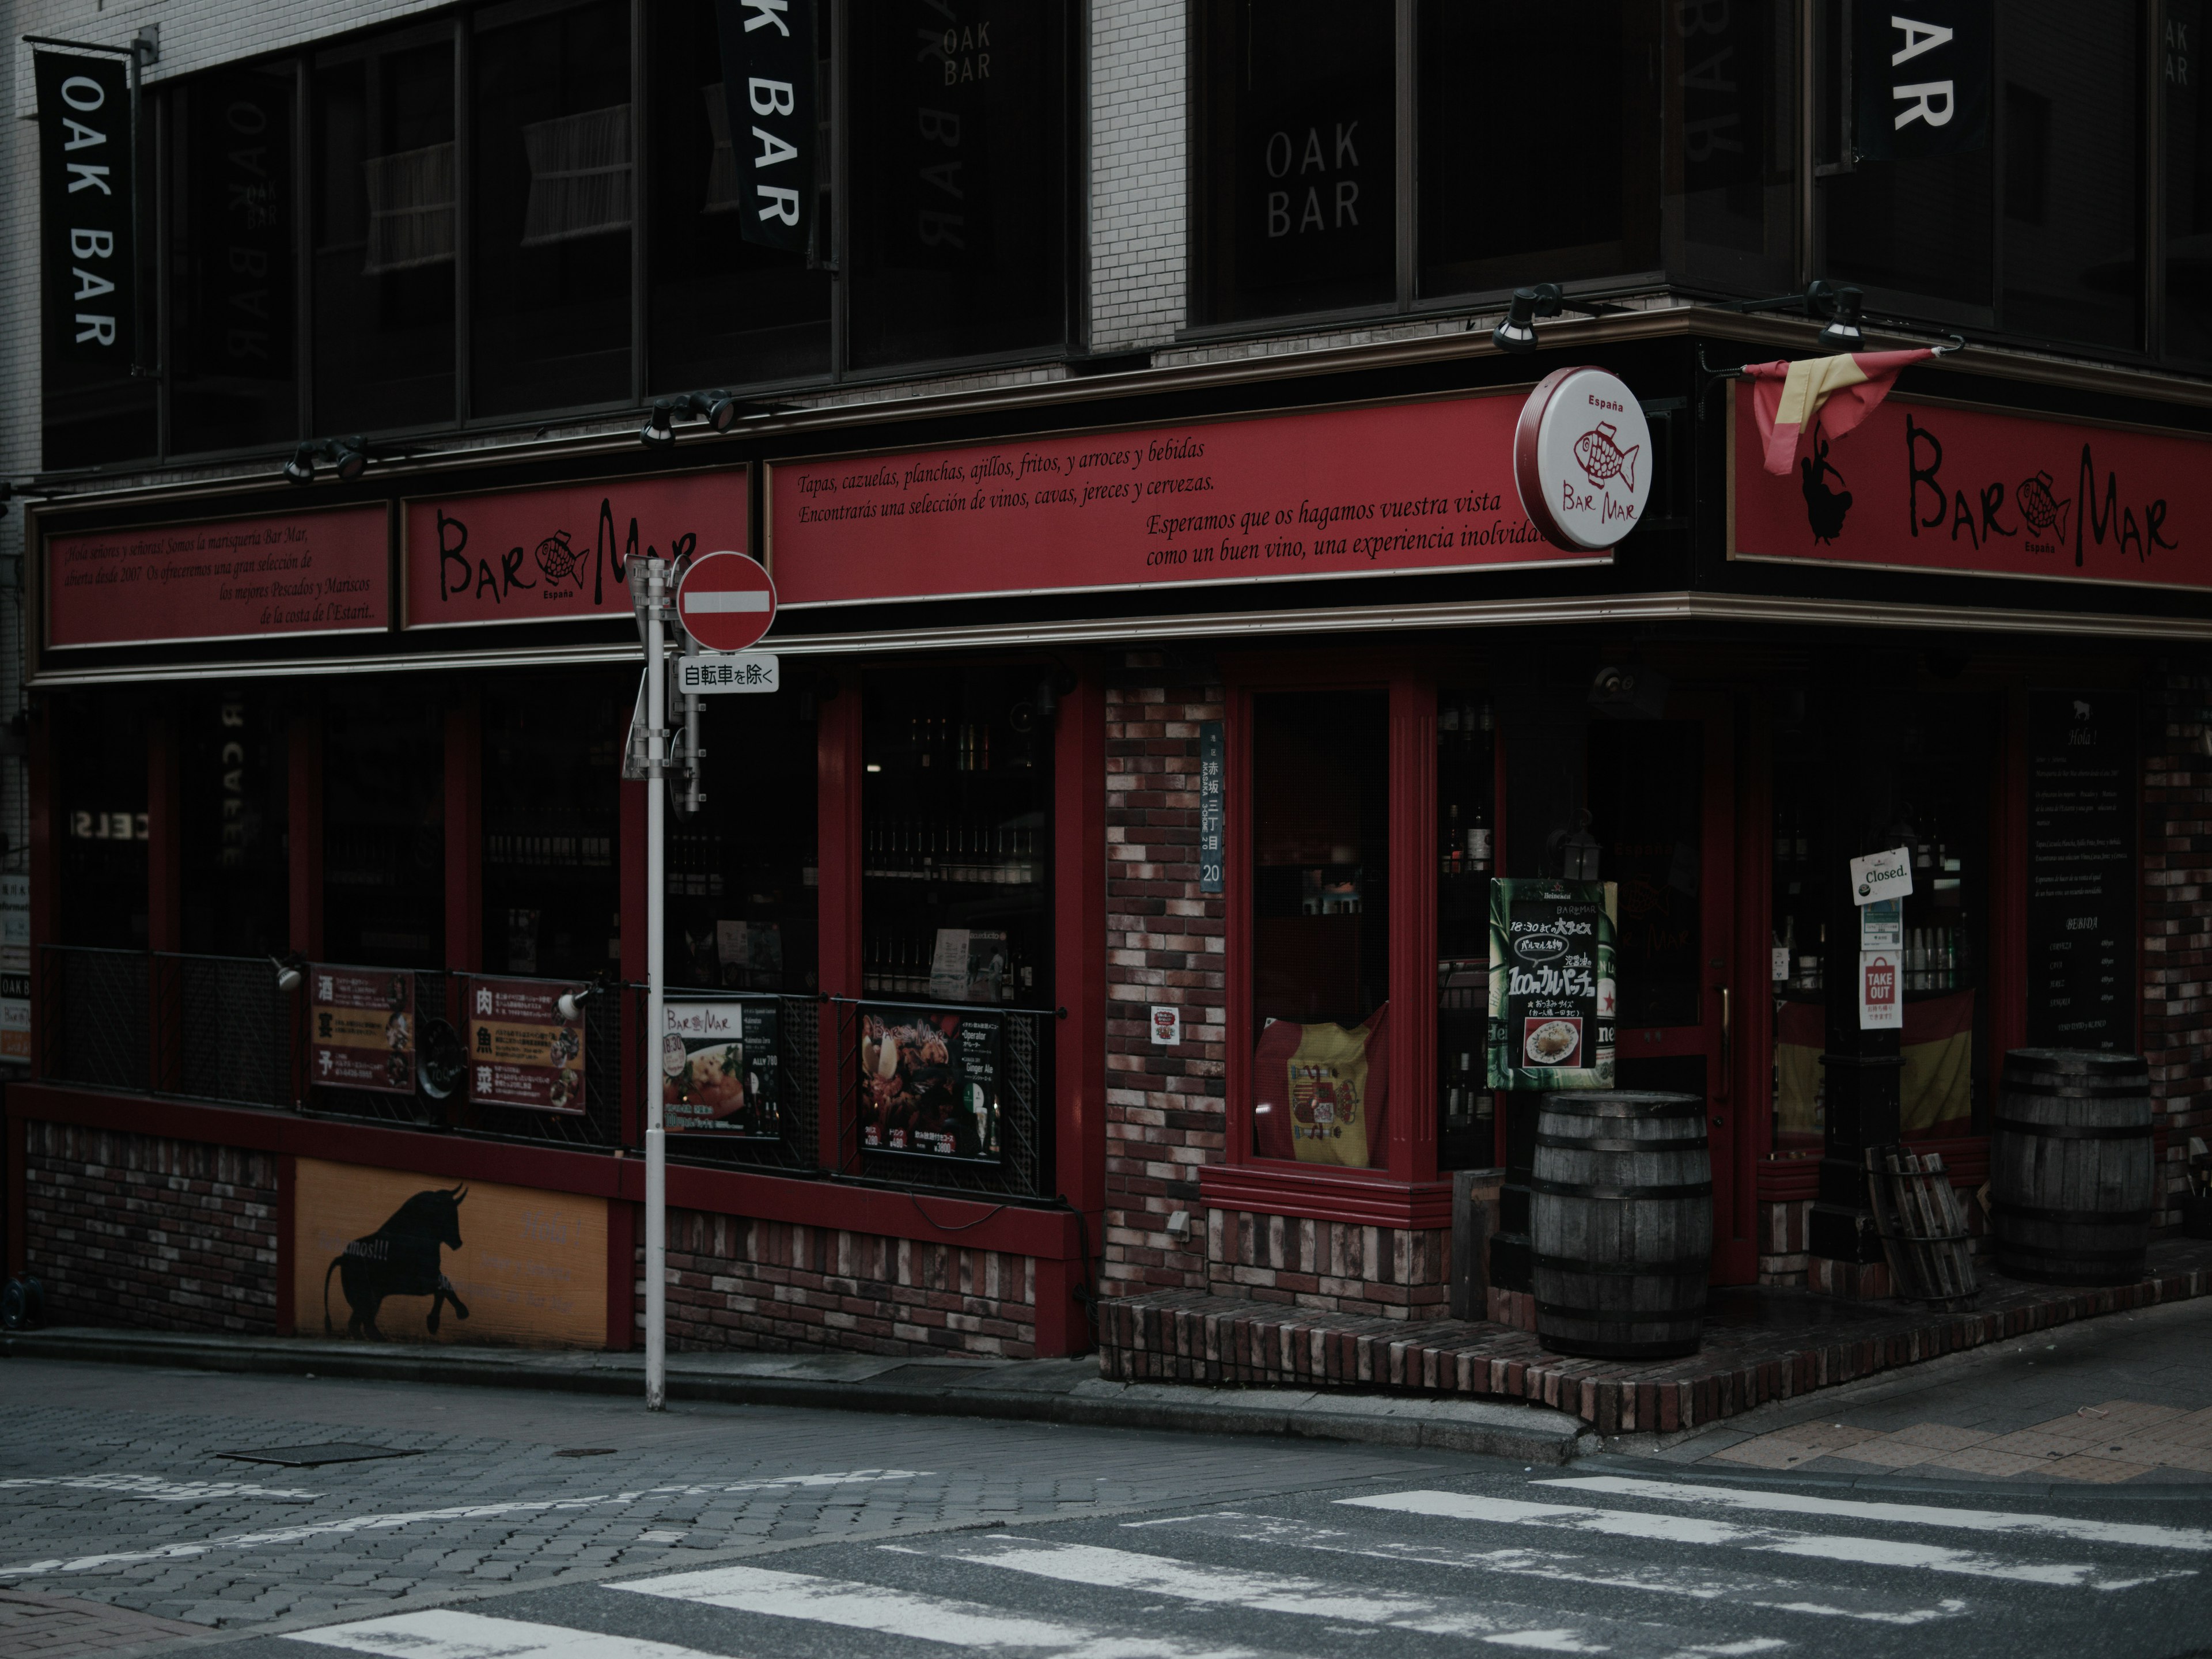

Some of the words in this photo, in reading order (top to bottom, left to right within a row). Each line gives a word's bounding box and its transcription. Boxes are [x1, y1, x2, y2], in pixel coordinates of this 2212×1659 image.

[942, 21, 991, 55] OAK
[2165, 24, 2188, 51] AK
[944, 54, 991, 86] BAR
[1891, 16, 1955, 130] AR
[2165, 56, 2188, 85] AR
[60, 75, 111, 196] OAK
[1266, 120, 1359, 179] OAK
[748, 77, 800, 228] BAR
[1268, 180, 1360, 238] BAR
[70, 228, 117, 347] BAR
[1589, 395, 1623, 412] España
[798, 474, 837, 498] Tapas,
[842, 466, 899, 489] cazuelas,
[903, 461, 965, 490] planchas,
[970, 456, 1013, 484] ajillos,
[1016, 453, 1060, 480] fritos,
[1065, 456, 1075, 476] y
[1079, 450, 1130, 468] arroces
[1132, 449, 1143, 470] y
[1149, 437, 1205, 461] bebidas
[798, 501, 877, 523] Encontrarás
[881, 502, 905, 517] una
[909, 493, 965, 514] selección
[970, 489, 986, 510] de
[990, 488, 1029, 509] vinos,
[1035, 488, 1077, 505] cavas,
[1080, 482, 1128, 507] jereces
[1131, 483, 1142, 503] y
[1147, 476, 1214, 495] cervezas.
[1906, 413, 2018, 550] BAR
[2075, 443, 2179, 567] MAR
[1147, 512, 1236, 540] Esperamos
[1241, 510, 1270, 535] que
[1275, 509, 1293, 524] os
[1298, 499, 1374, 530] hagamos
[1380, 497, 1448, 517] vuestra
[1454, 490, 1501, 512] vista
[90, 544, 120, 559] señores
[121, 547, 127, 562] y
[166, 538, 194, 554] Somos
[197, 533, 205, 551] la
[263, 529, 282, 544] Bar
[284, 527, 308, 543] Mar,
[1147, 549, 1187, 566] como
[1193, 548, 1214, 563] un
[1220, 539, 1259, 561] buen
[1264, 536, 1306, 560] vino,
[1314, 537, 1346, 555] una
[1353, 529, 1454, 559] experiencia
[2025, 541, 2055, 555] España
[65, 570, 93, 586] abierta
[95, 566, 118, 585] desde
[120, 566, 142, 582] 2007
[147, 565, 158, 580] Os
[161, 562, 211, 585] ofreceremos
[214, 562, 231, 575] una
[233, 560, 255, 579] gran
[257, 553, 297, 571] selección
[301, 550, 312, 567] de
[219, 583, 233, 600] los
[235, 588, 268, 605] mejores
[271, 577, 313, 597] Pescados
[315, 583, 323, 600] y
[324, 575, 370, 594] Mariscos
[543, 589, 574, 600] España
[260, 607, 271, 624] de
[274, 606, 283, 624] la
[285, 608, 309, 622] costa
[313, 604, 324, 622] de
[684, 664, 773, 686] 自転車を除く
[2068, 728, 2091, 746] Hola
[1208, 762, 1218, 850] 赤坂三丁目
[1203, 864, 1219, 881] 20
[1866, 865, 1907, 883] Closed.
[2065, 916, 2100, 930] BEBIDA
[2050, 942, 2072, 951] CERVEZA
[2, 978, 21, 994] OAK
[318, 975, 333, 1001] 酒
[1868, 973, 1892, 986] TAKE
[1870, 986, 1890, 999] OUT
[476, 987, 493, 1016] 肉
[319, 1012, 332, 1038] 宴
[964, 1029, 986, 1041] Operator
[476, 1026, 493, 1054] 魚
[664, 1035, 681, 1054] 18:30
[319, 1050, 333, 1077] 予
[966, 1063, 983, 1074] Ginger
[984, 1064, 993, 1073] Ale
[476, 1066, 493, 1094] 菜
[889, 1128, 903, 1137] ドリンク
[520, 1210, 567, 1245] Hola
